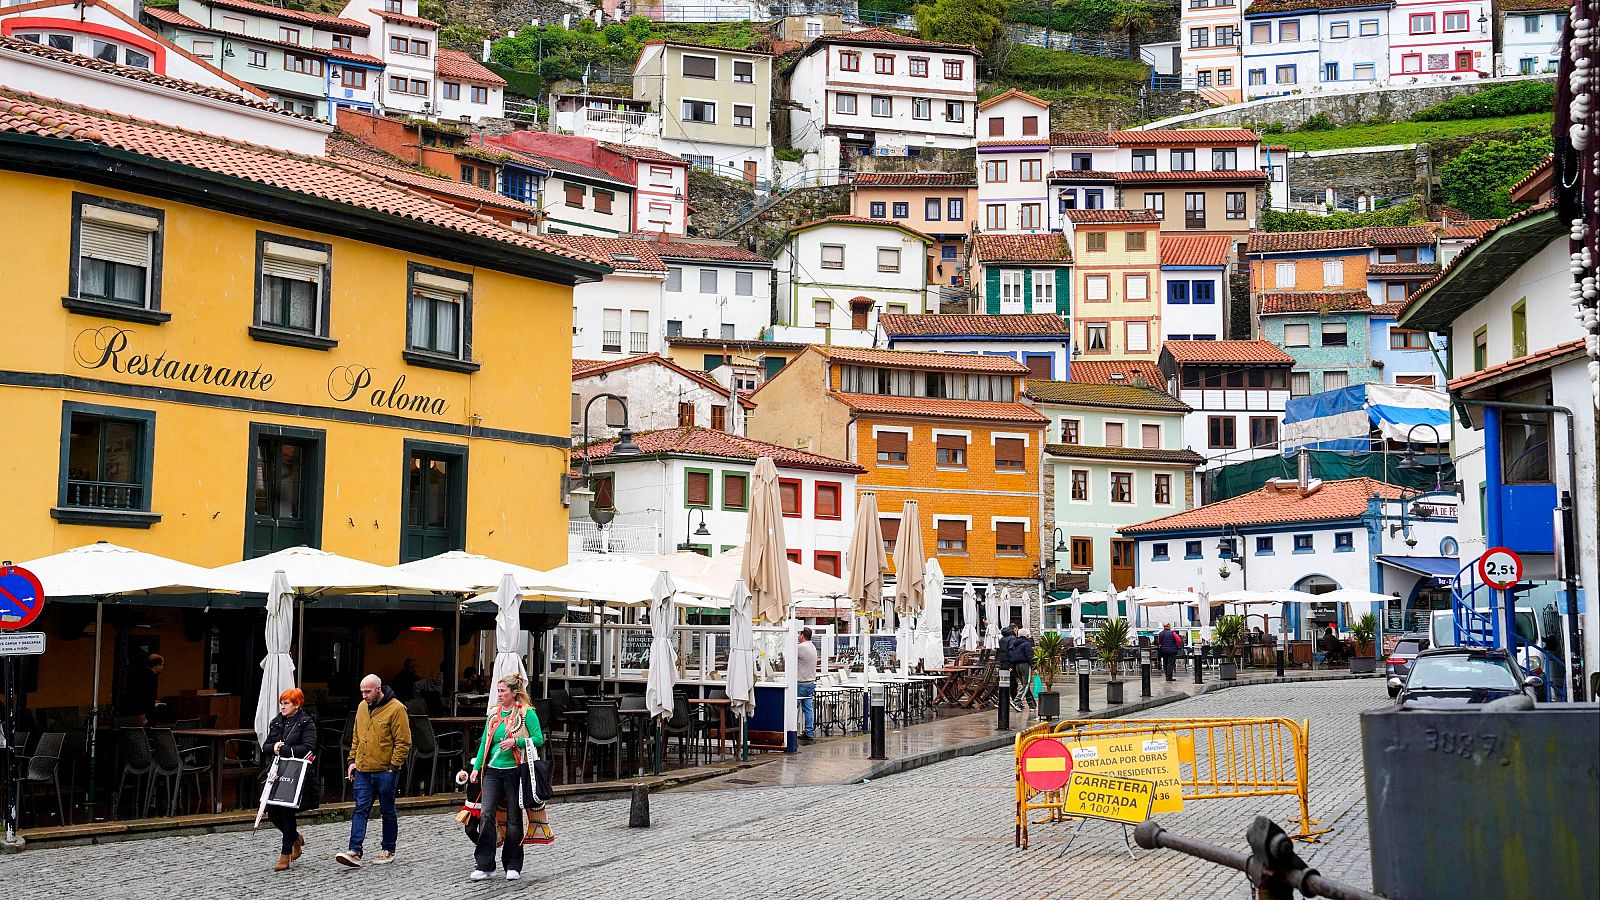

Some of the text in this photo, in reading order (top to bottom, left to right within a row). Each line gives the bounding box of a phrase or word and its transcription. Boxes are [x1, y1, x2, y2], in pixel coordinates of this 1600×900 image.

[73, 326, 451, 416] Restaurante Paloma
[1440, 507, 1448, 516] DE
[1449, 506, 1458, 517] PE
[1109, 743, 1133, 753] CALLE
[1145, 744, 1167, 752] elecnor
[1074, 751, 1096, 759] elecnor
[1078, 752, 1167, 768] CORTADA POR OBRAS
[1117, 767, 1169, 777] RESIDENTES.
[1074, 775, 1148, 794] CARRETERA
[1155, 778, 1180, 788] ASTA
[1078, 790, 1138, 809] CORTADA
[1160, 792, 1170, 800] 36
[1079, 802, 1120, 816] A 100 M
